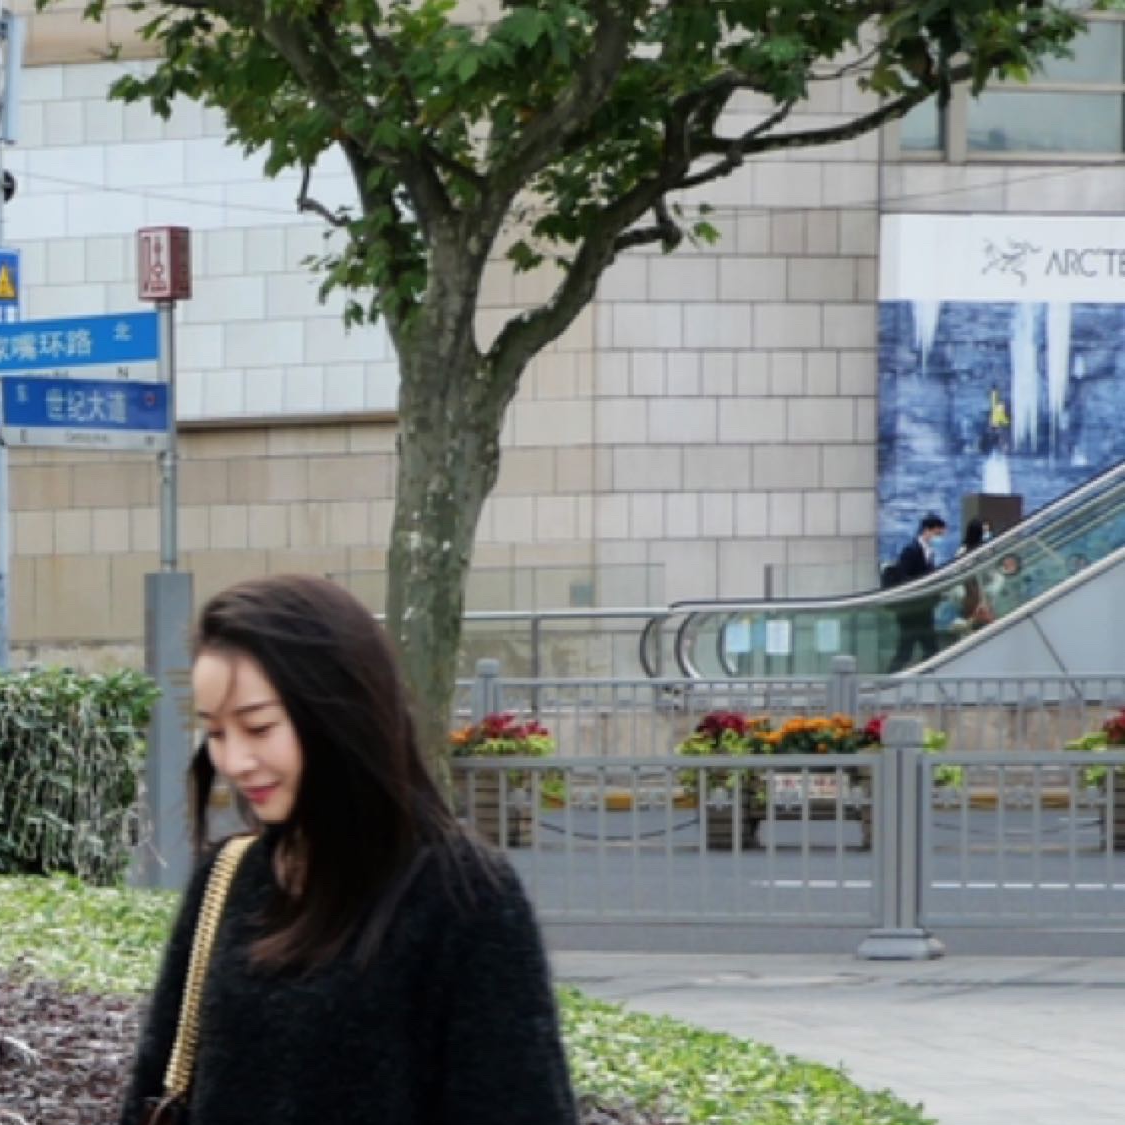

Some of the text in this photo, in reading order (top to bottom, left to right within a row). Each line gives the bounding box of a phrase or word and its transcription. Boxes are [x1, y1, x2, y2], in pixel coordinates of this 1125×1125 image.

[113, 321, 132, 341] 北
[45, 388, 127, 423] 世纪大道
